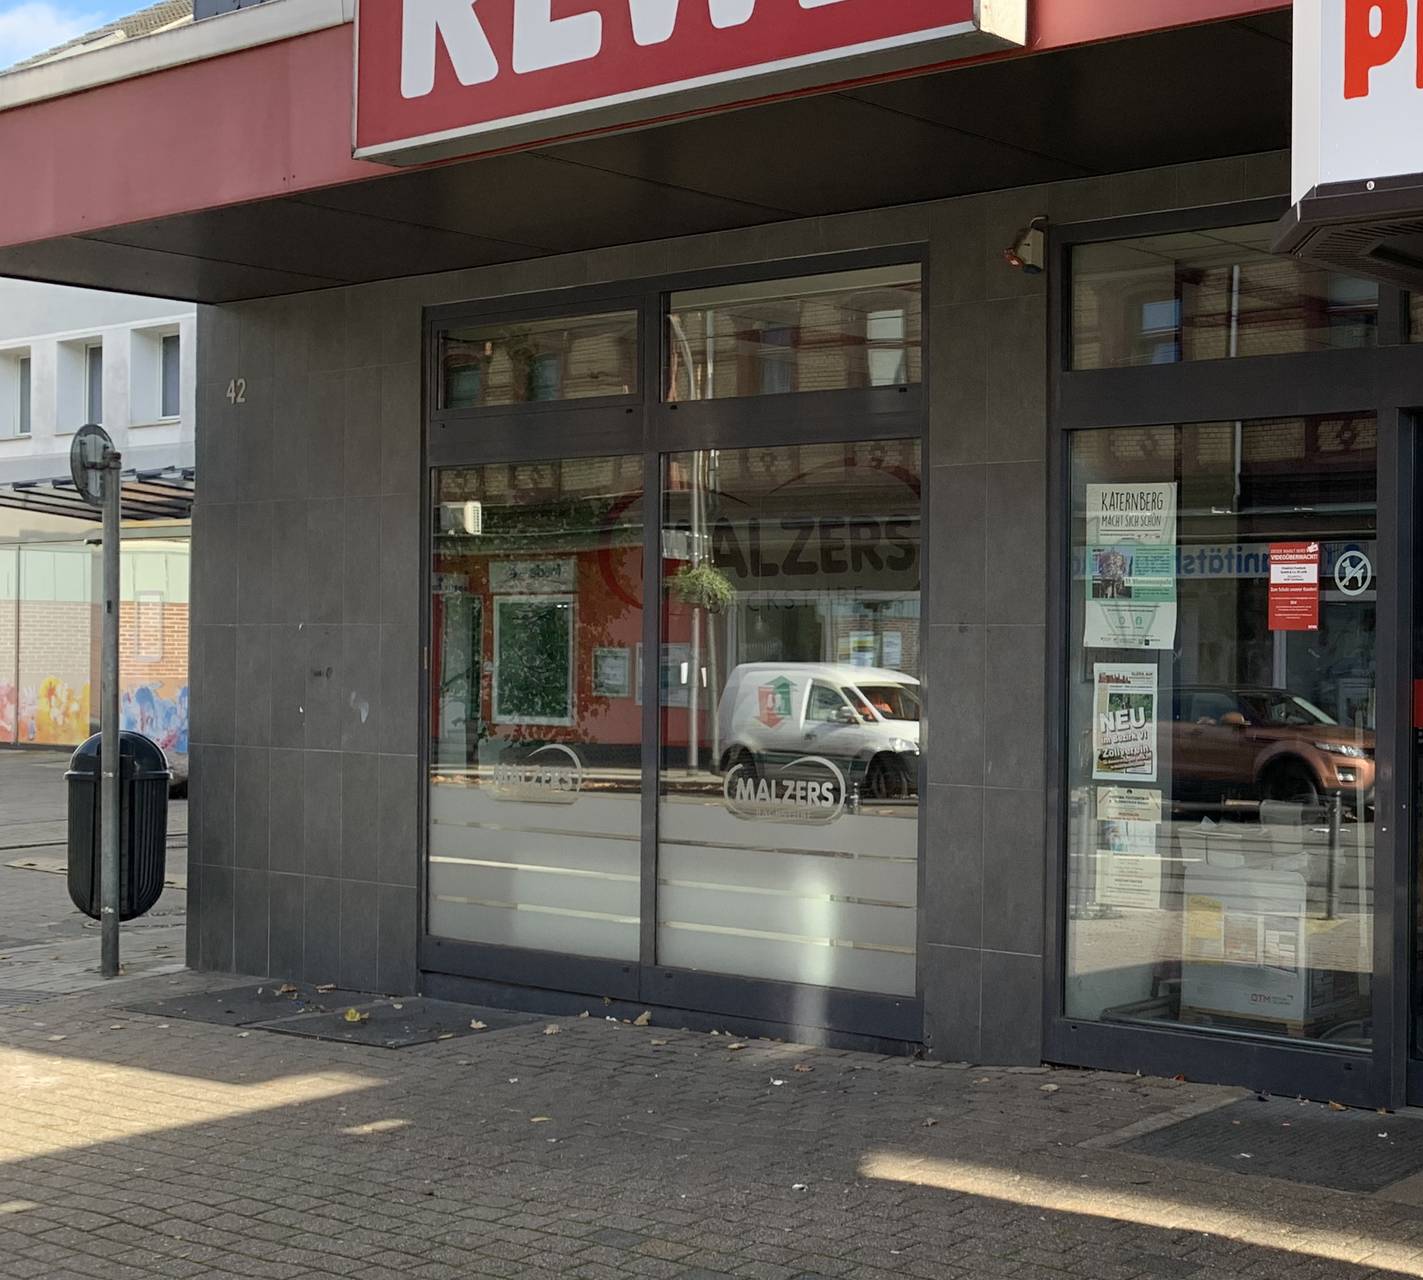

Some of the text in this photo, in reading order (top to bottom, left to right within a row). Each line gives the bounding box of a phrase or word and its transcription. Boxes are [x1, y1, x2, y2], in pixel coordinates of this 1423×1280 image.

[226, 378, 246, 404] 42
[1101, 491, 1164, 512] KATERNBERG
[1101, 515, 1124, 527] MACHT
[676, 514, 917, 578] ALZERS
[1100, 706, 1147, 733] NEU
[736, 777, 835, 808] MALZERS
